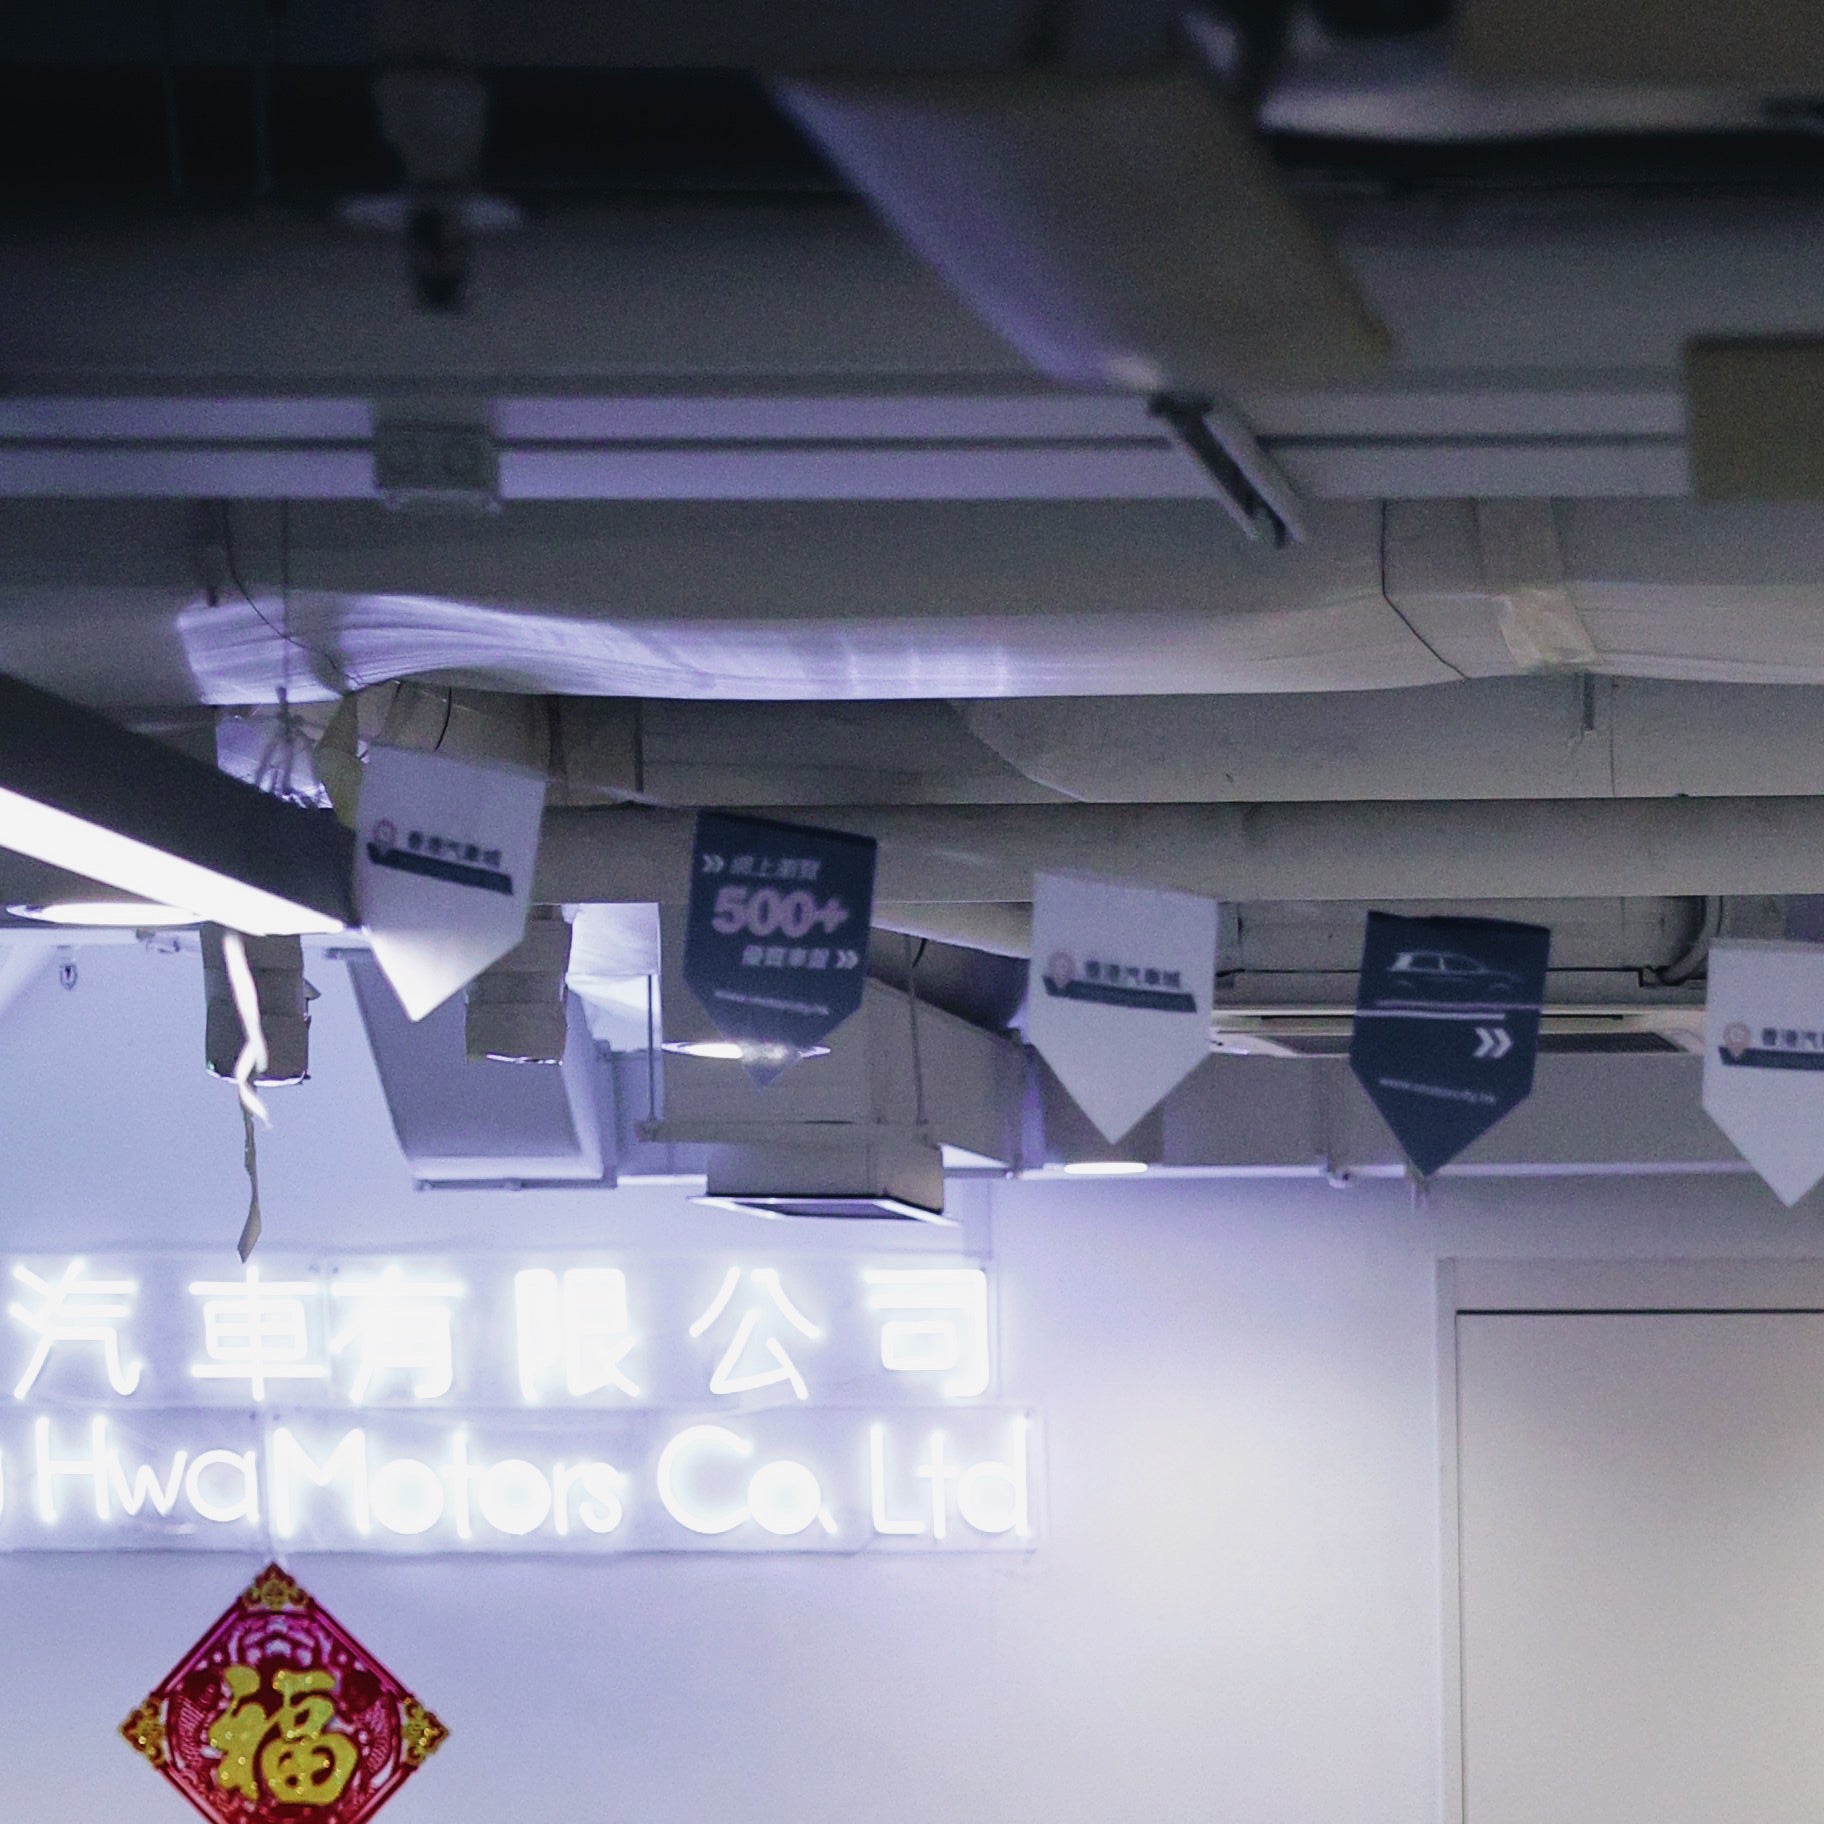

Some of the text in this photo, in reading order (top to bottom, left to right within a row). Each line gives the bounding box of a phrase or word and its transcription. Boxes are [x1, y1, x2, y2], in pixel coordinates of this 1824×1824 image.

[712, 884, 849, 938] 500+
[10, 1259, 990, 1402] 汽車有限公司
[35, 1416, 260, 1523] Hwa
[272, 1427, 629, 1539] Motors
[870, 1416, 1030, 1538] Ltd
[208, 1664, 359, 1806] 福
